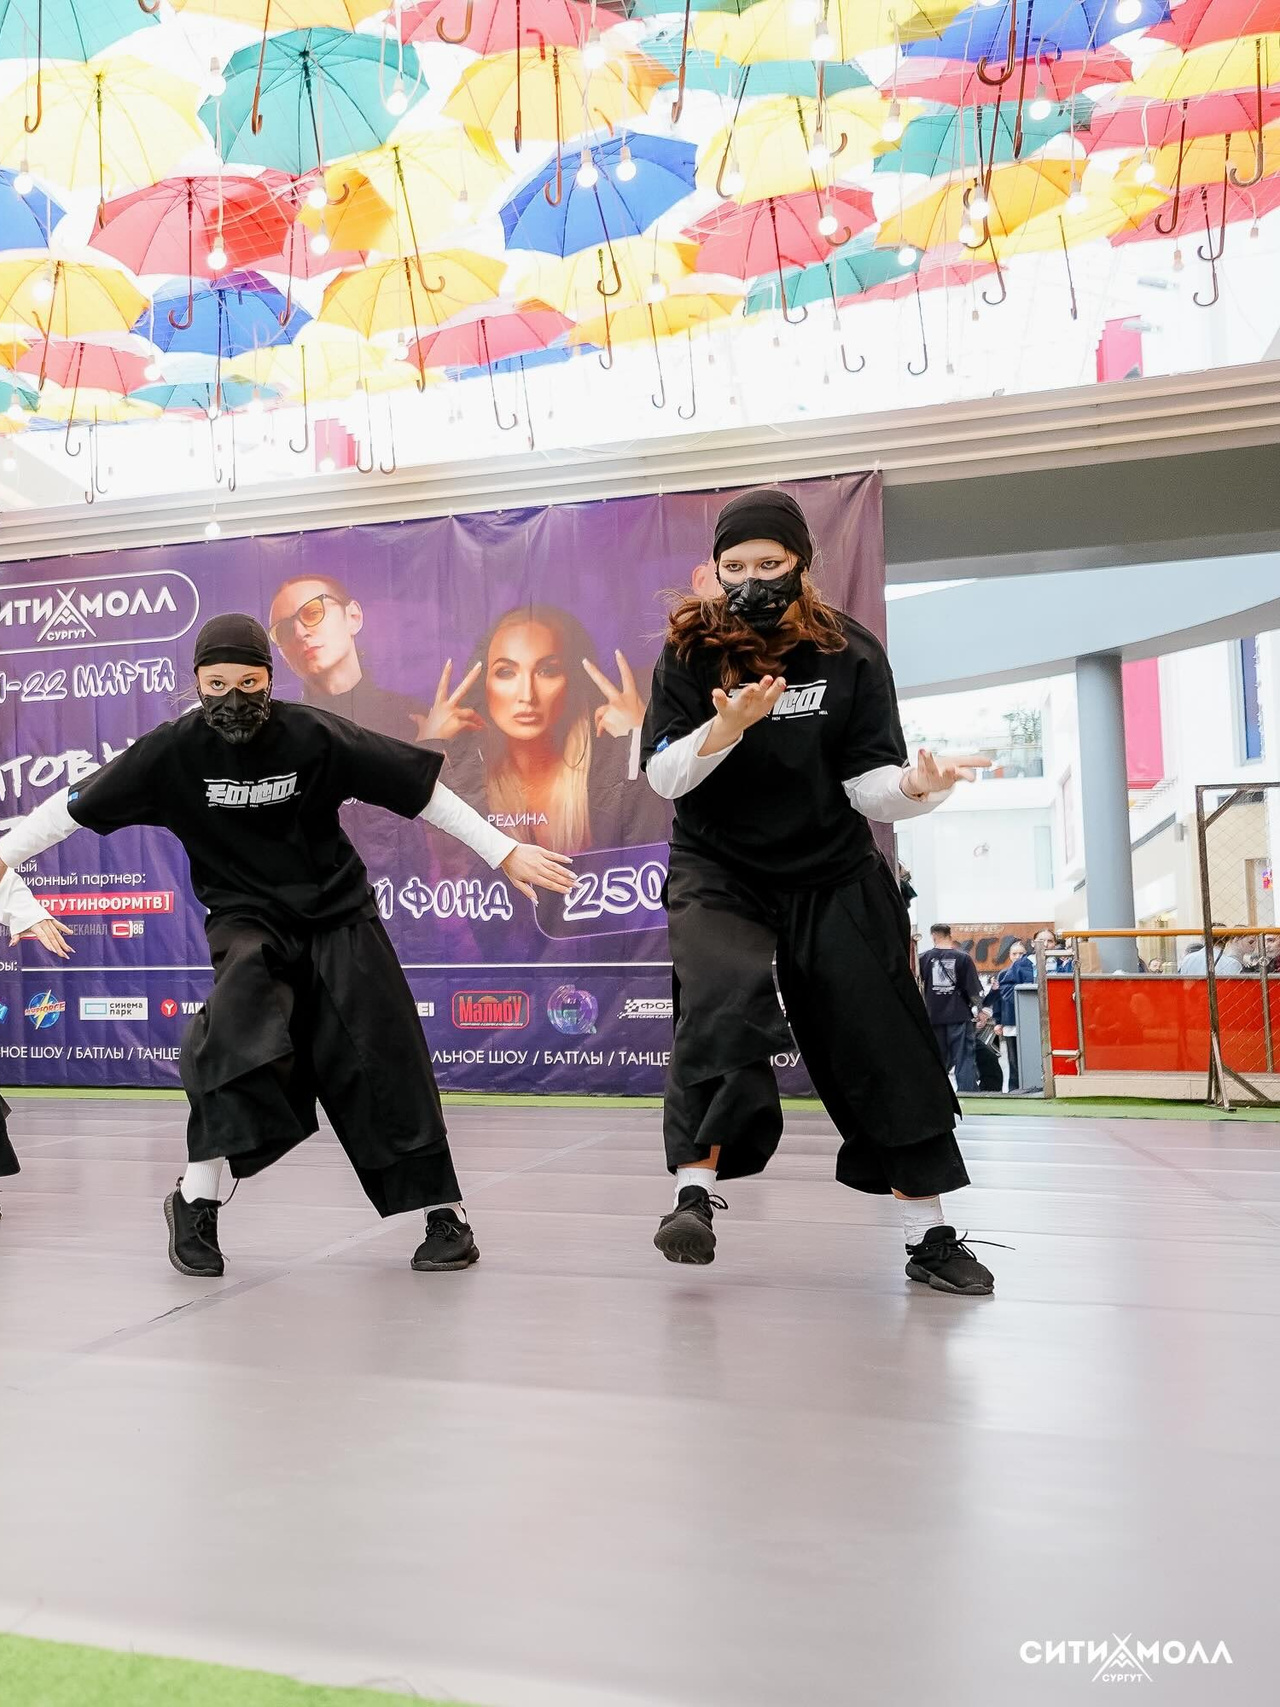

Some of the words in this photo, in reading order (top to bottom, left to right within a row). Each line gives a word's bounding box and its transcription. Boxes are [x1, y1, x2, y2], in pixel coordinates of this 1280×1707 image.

[47, 629, 87, 641] СУРГУТ
[73, 657, 177, 699] МАРТА
[23, 873, 78, 887] ионный
[82, 873, 146, 888] партнер:
[399, 877, 513, 921] ФОНД
[109, 1009, 132, 1017] парк
[30, 1046, 64, 1059] ШОУ
[75, 1047, 124, 1060] БАТТЛЫ
[137, 1047, 181, 1061] ТАНЦЕ
[431, 1050, 485, 1064] ЛЬНОЕ
[488, 1050, 528, 1064] ШОУ
[544, 1051, 603, 1065] БАТТЛЫ
[619, 1051, 671, 1067] ТАНЦЕ
[770, 1052, 801, 1067] ОУ
